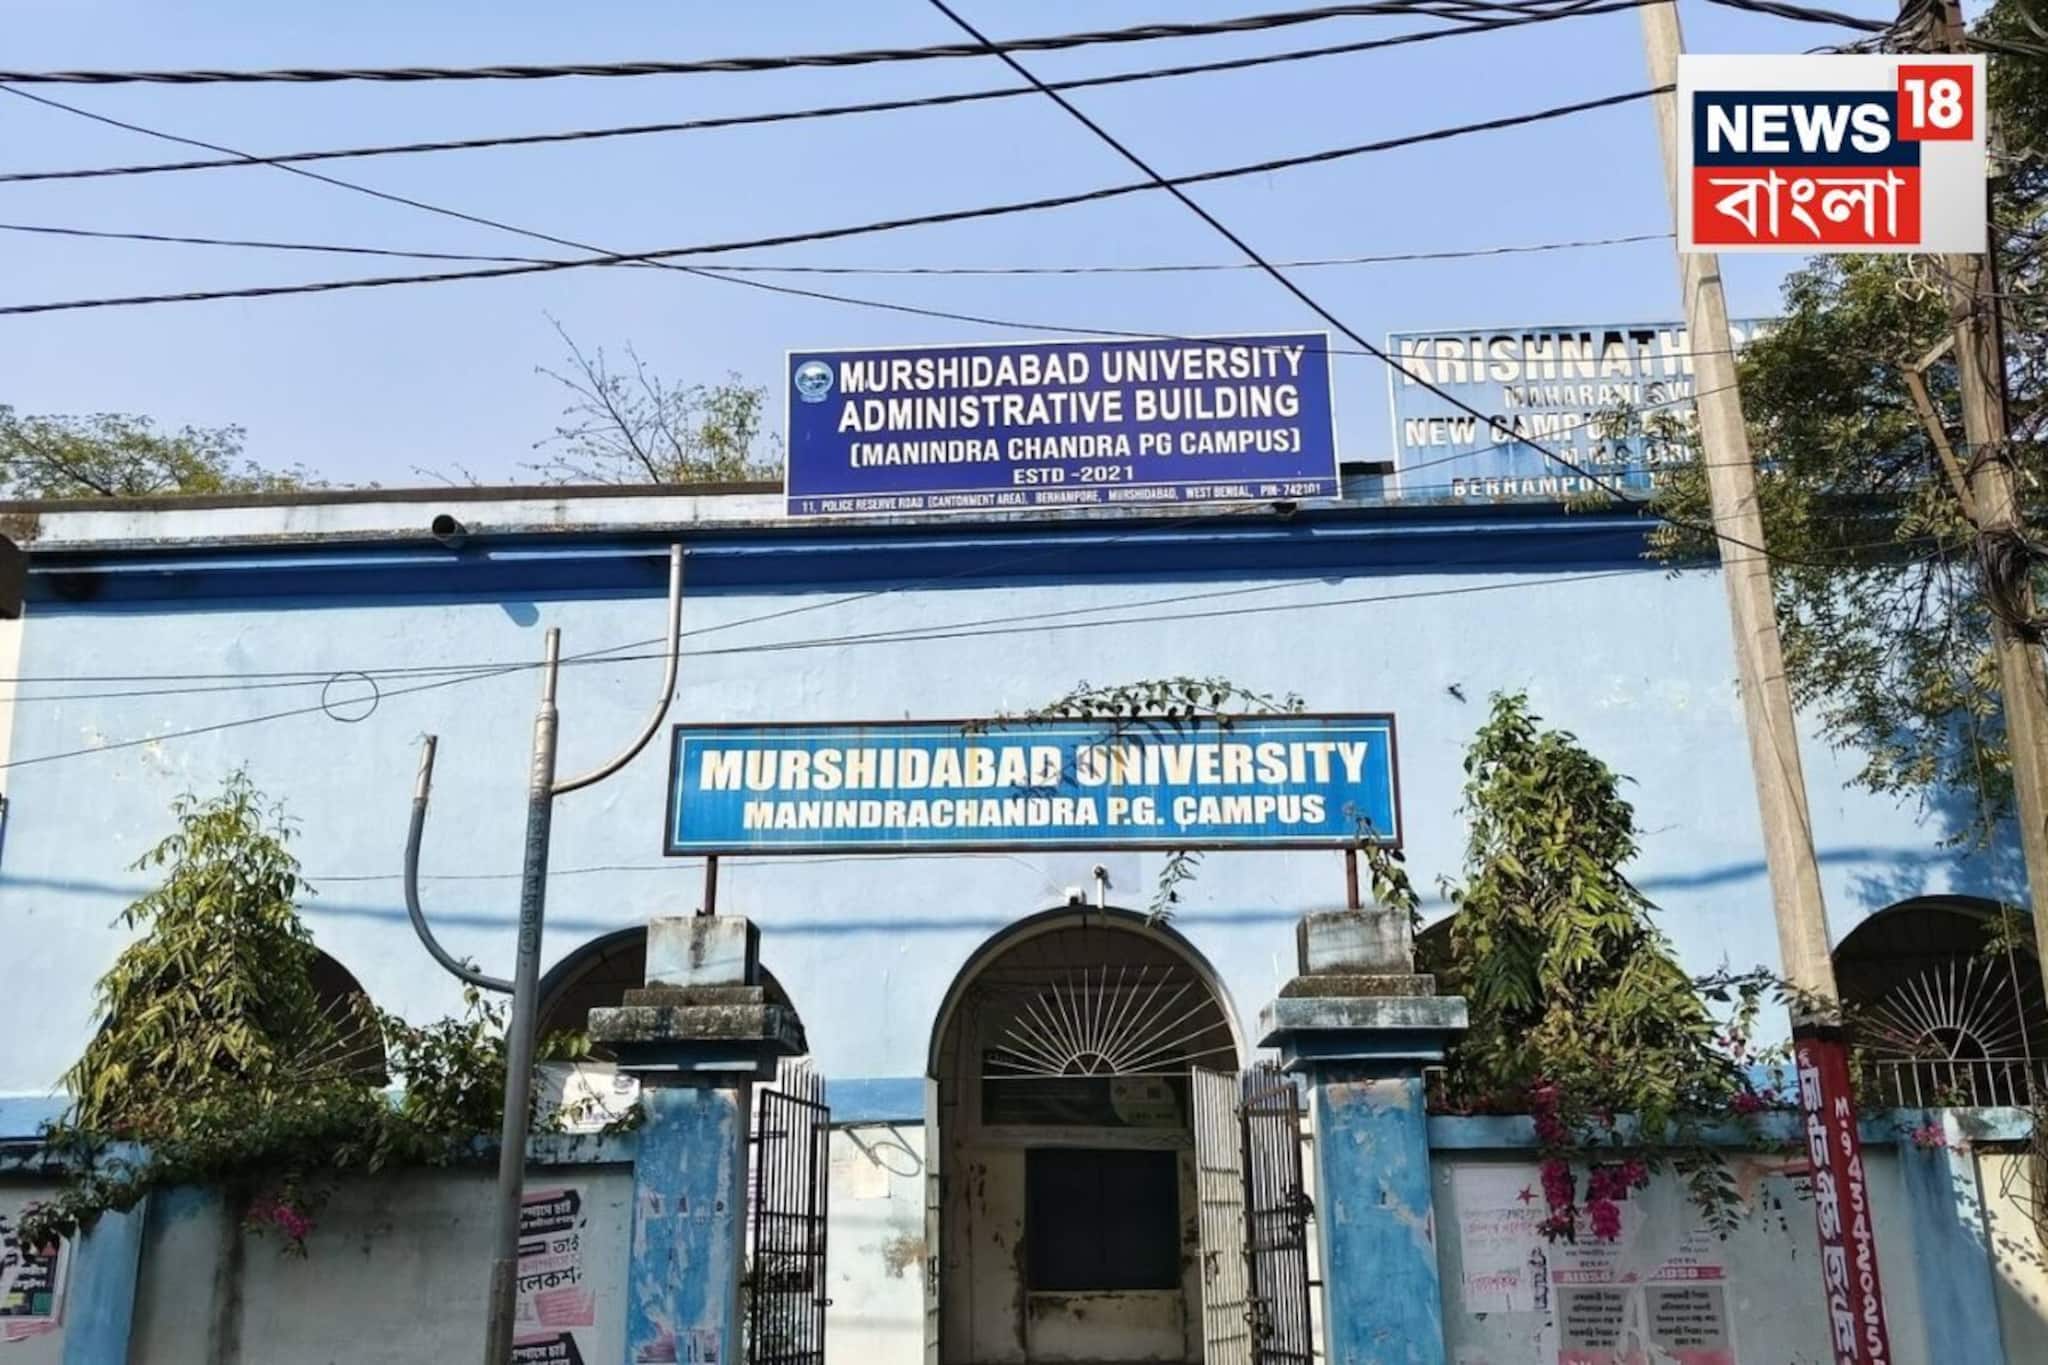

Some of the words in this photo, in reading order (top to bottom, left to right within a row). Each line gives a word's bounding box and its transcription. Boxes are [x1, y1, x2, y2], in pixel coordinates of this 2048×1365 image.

[840, 352, 1090, 393] MURSHIDABAD
[1102, 345, 1304, 383] UNIVERSITY
[1400, 328, 1695, 385] KRISHNATH
[838, 390, 1123, 432] ADMINISTRATIVE
[1135, 384, 1299, 421] BUILDING
[1008, 433, 1131, 461] CHANDRA
[1139, 432, 1172, 456] PG
[1405, 417, 1476, 447] NEW
[1013, 468, 1065, 484] ESTD
[1071, 465, 1133, 482] -2021
[821, 501, 854, 513] POLICE
[856, 498, 897, 511] RESERVE
[898, 496, 923, 509] ROAD
[1108, 486, 1179, 502] MURSHIDABAD,
[1186, 486, 1213, 500] WEST
[700, 745, 1061, 791] MURSHIDABAD
[1076, 741, 1368, 786] UNIVERSITY
[743, 797, 1099, 830] MANINDRACHANDRA
[1107, 796, 1164, 826] P.G.
[1173, 794, 1326, 826] CAMPUS
